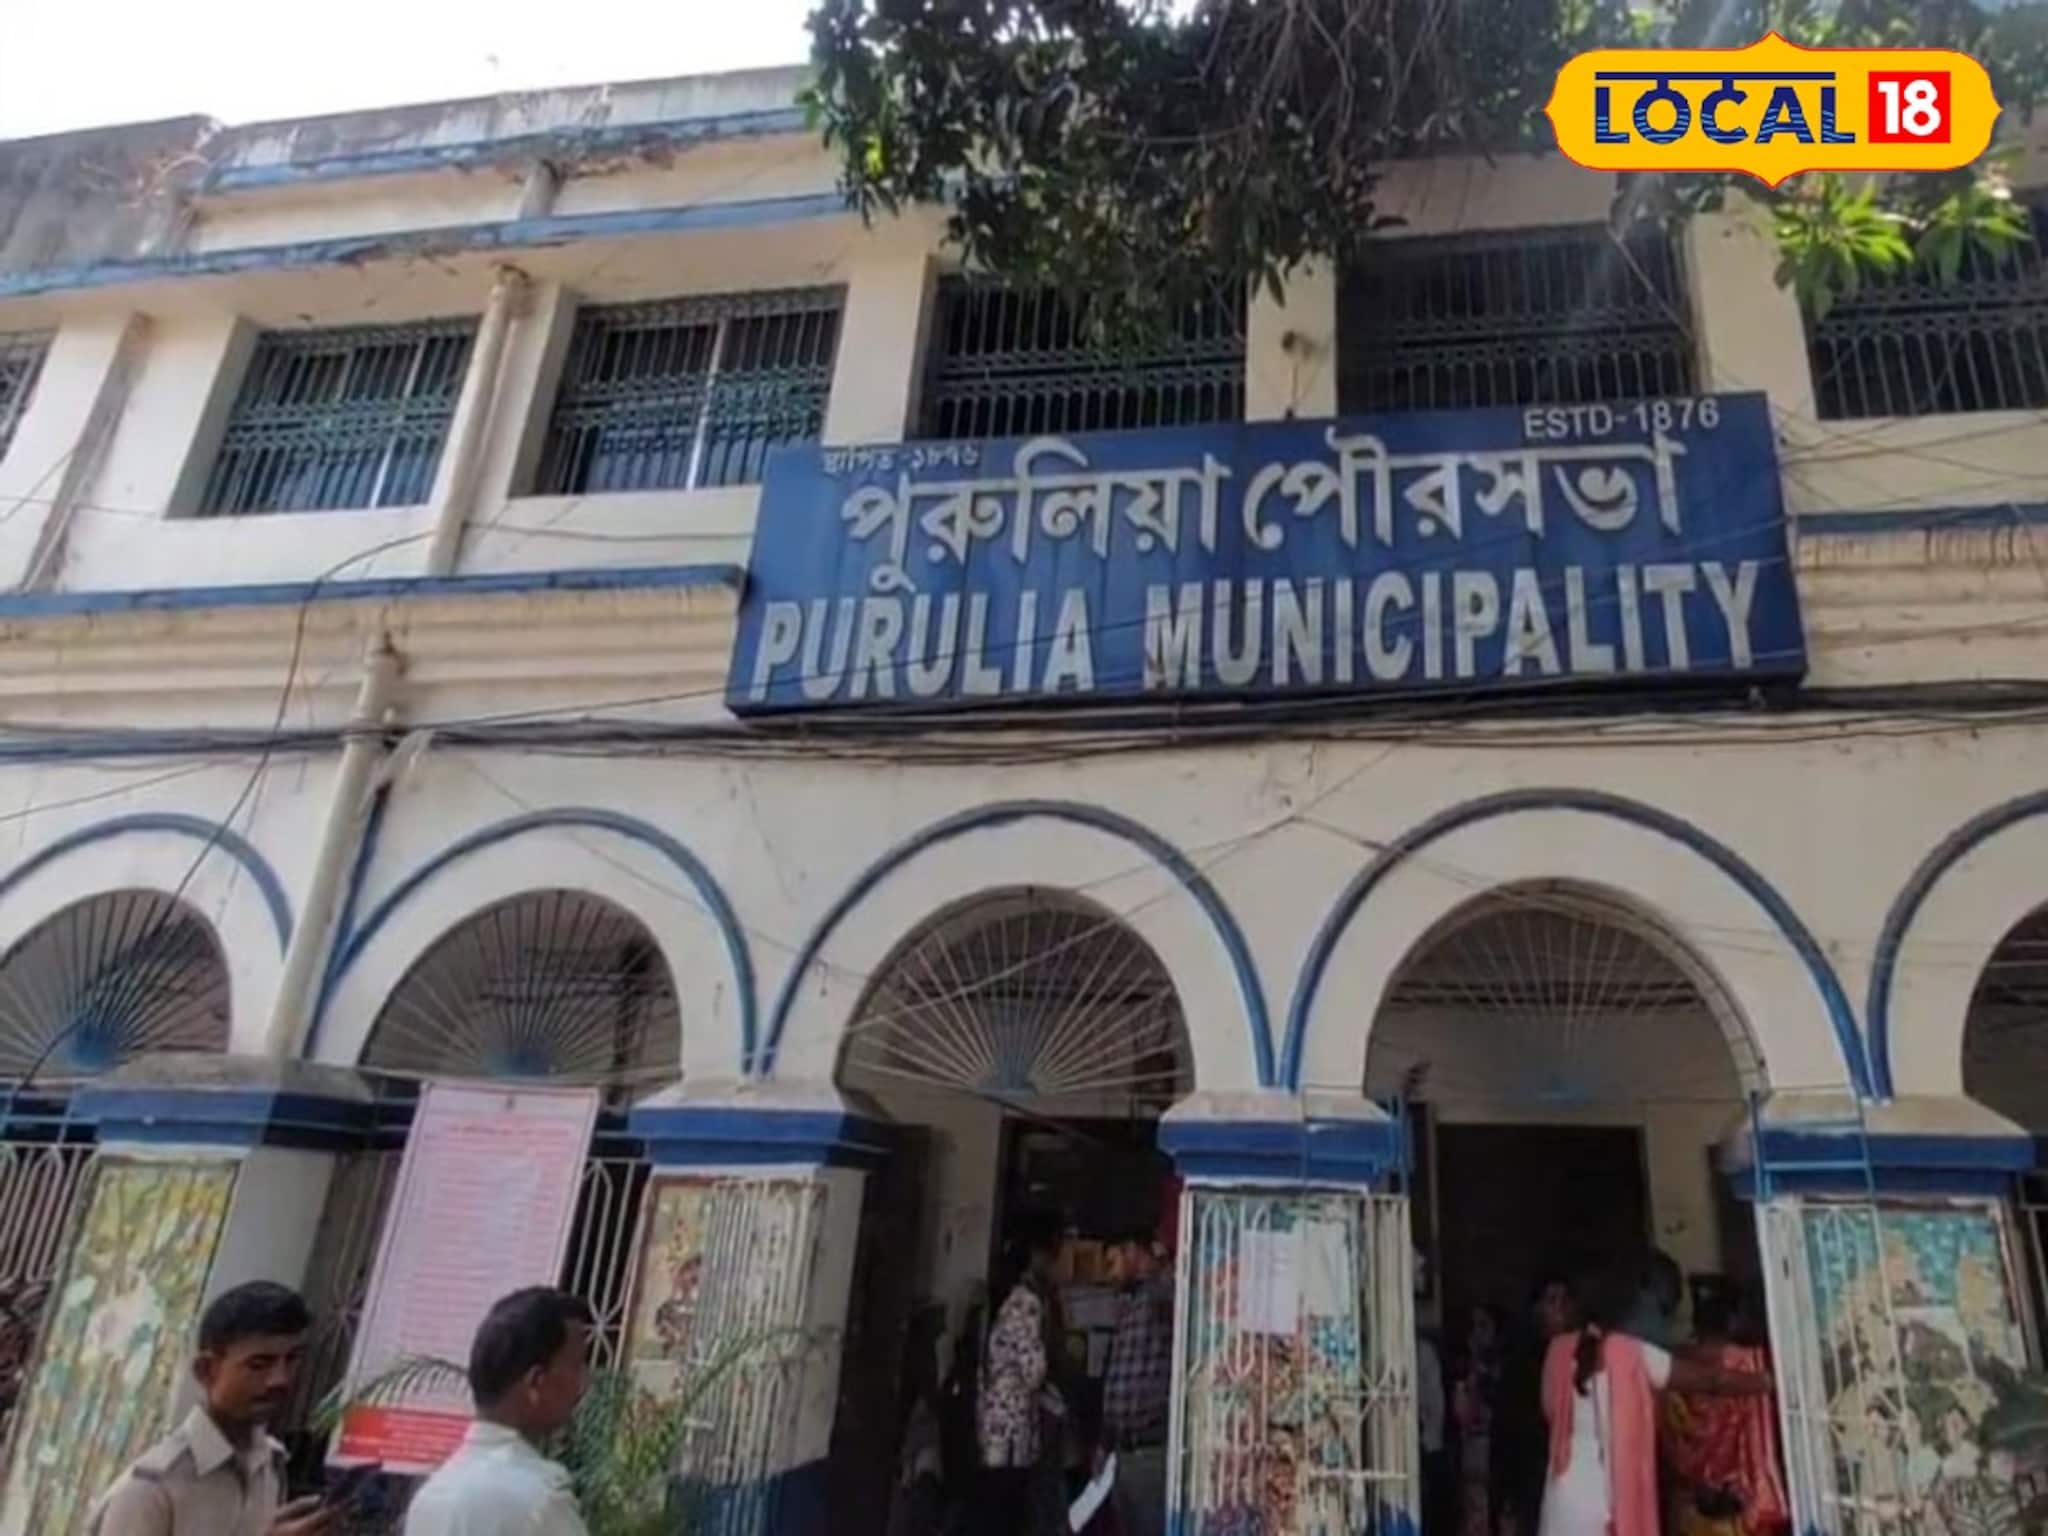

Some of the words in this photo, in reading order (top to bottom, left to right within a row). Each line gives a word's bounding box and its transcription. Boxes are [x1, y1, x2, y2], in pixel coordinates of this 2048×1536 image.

[1523, 398, 1720, 438] ESTD-1876
[840, 436, 1232, 593] পুরুলিয়া
[1243, 426, 1686, 549] পৌরসভা
[749, 587, 1096, 701] PURULIA
[1143, 560, 1760, 690] MUNICIPALITY
